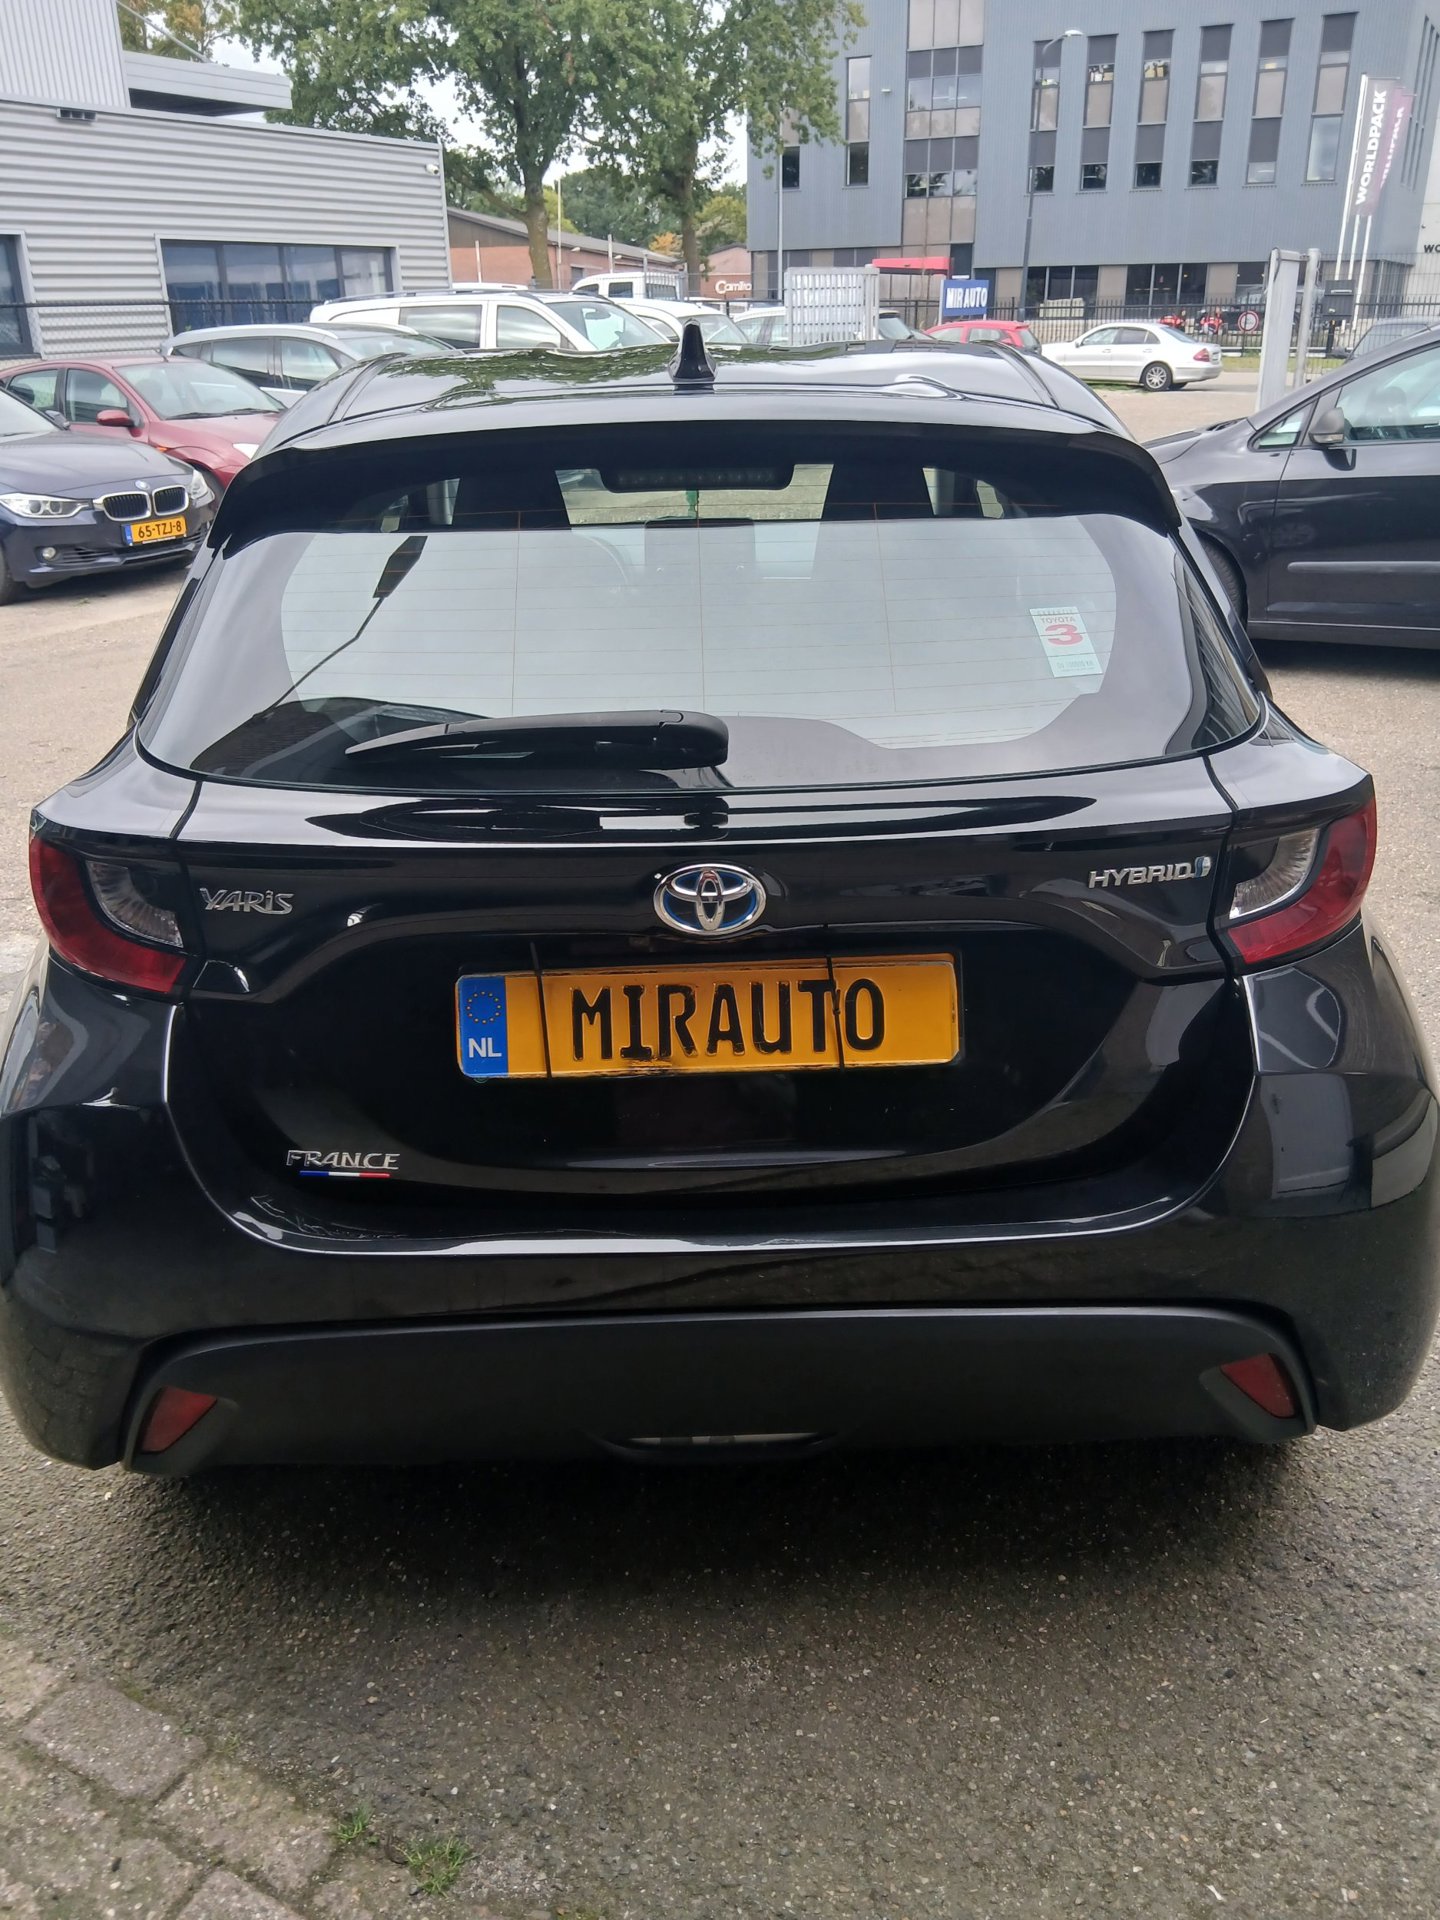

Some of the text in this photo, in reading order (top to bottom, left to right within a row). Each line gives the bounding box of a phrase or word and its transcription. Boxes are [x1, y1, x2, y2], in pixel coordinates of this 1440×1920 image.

[1355, 88, 1387, 206] WORLDPACK
[138, 520, 182, 539] 65-TZJ-8
[1040, 616, 1076, 624] TOYOTA
[1045, 624, 1083, 645] 3
[1088, 862, 1194, 889] HYBRID
[571, 977, 886, 1062] MIRAUTO
[468, 1037, 502, 1058] NL
[286, 1149, 401, 1170] FRANCE
